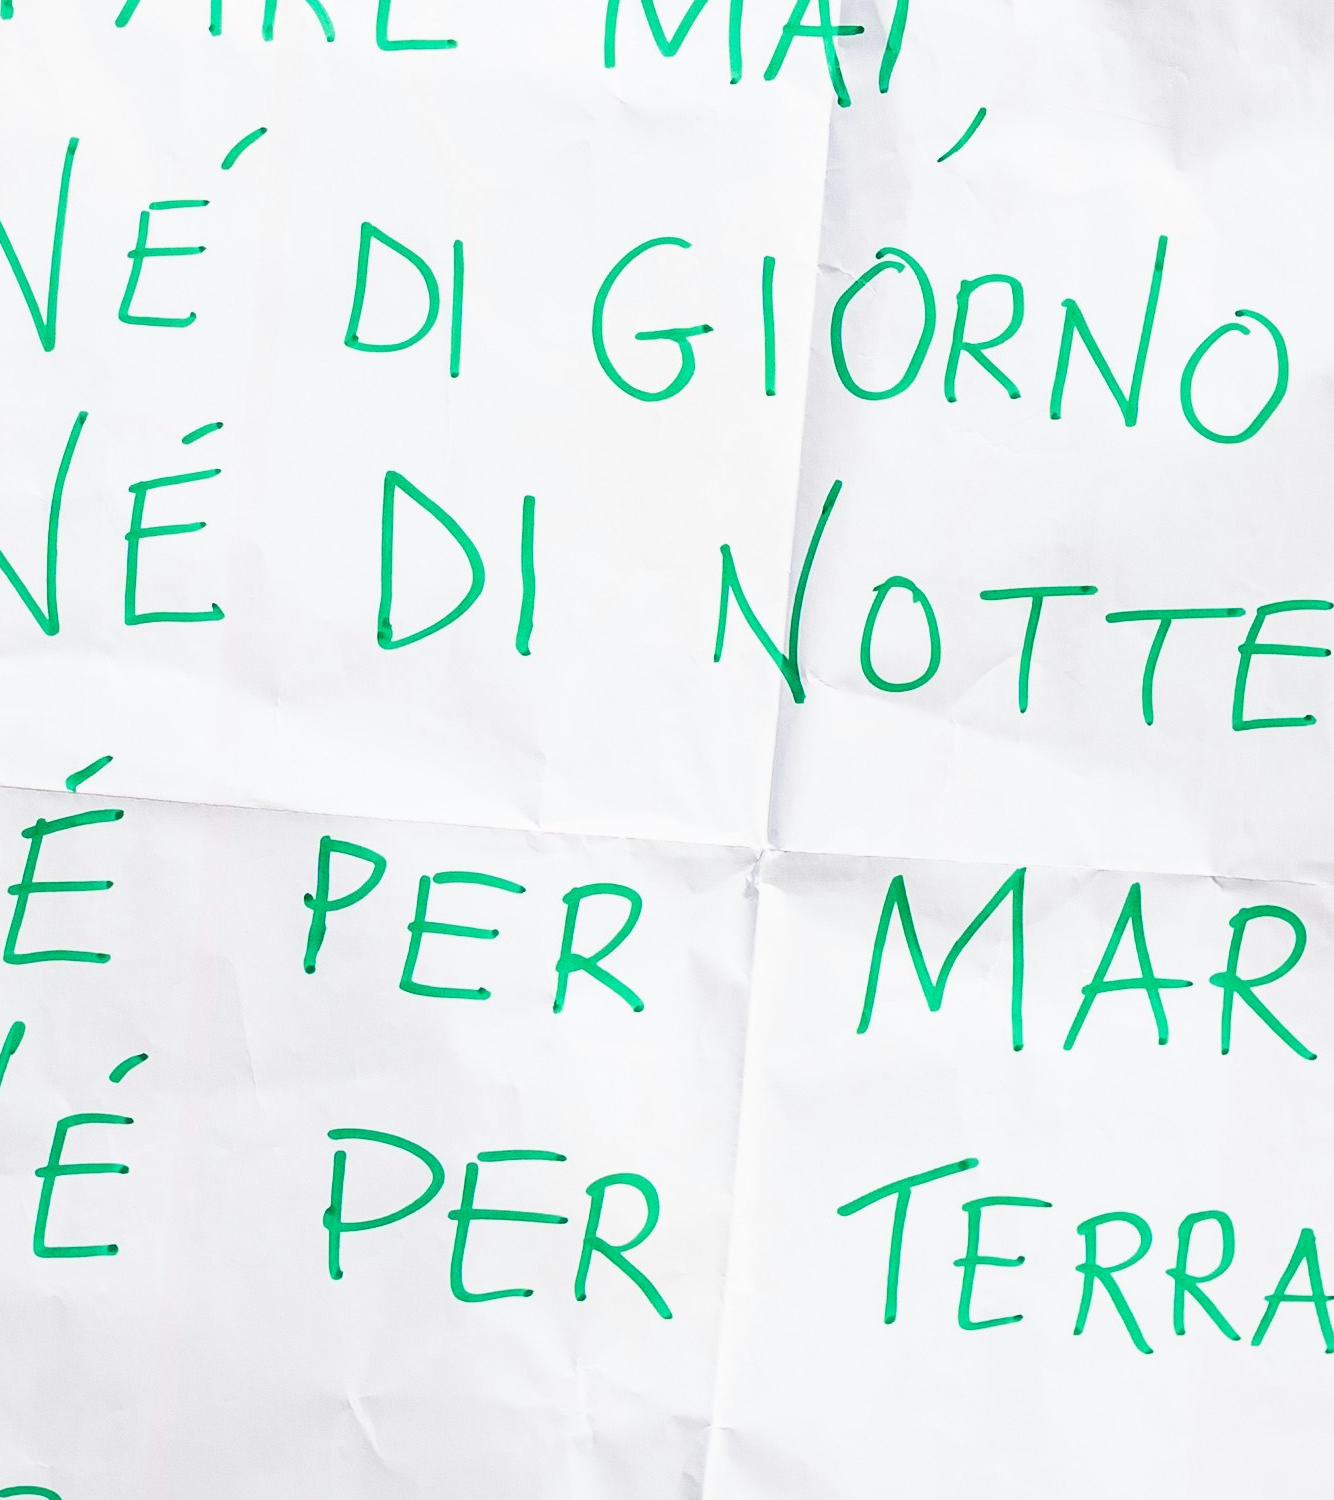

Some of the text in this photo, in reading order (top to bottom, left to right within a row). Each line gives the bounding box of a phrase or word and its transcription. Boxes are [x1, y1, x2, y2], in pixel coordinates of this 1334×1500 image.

[344, 222, 465, 379] DI
[592, 235, 1290, 445] GIORNO
[377, 471, 537, 657] DI
[303, 836, 645, 1015] PER
[323, 1128, 674, 1320] PER
